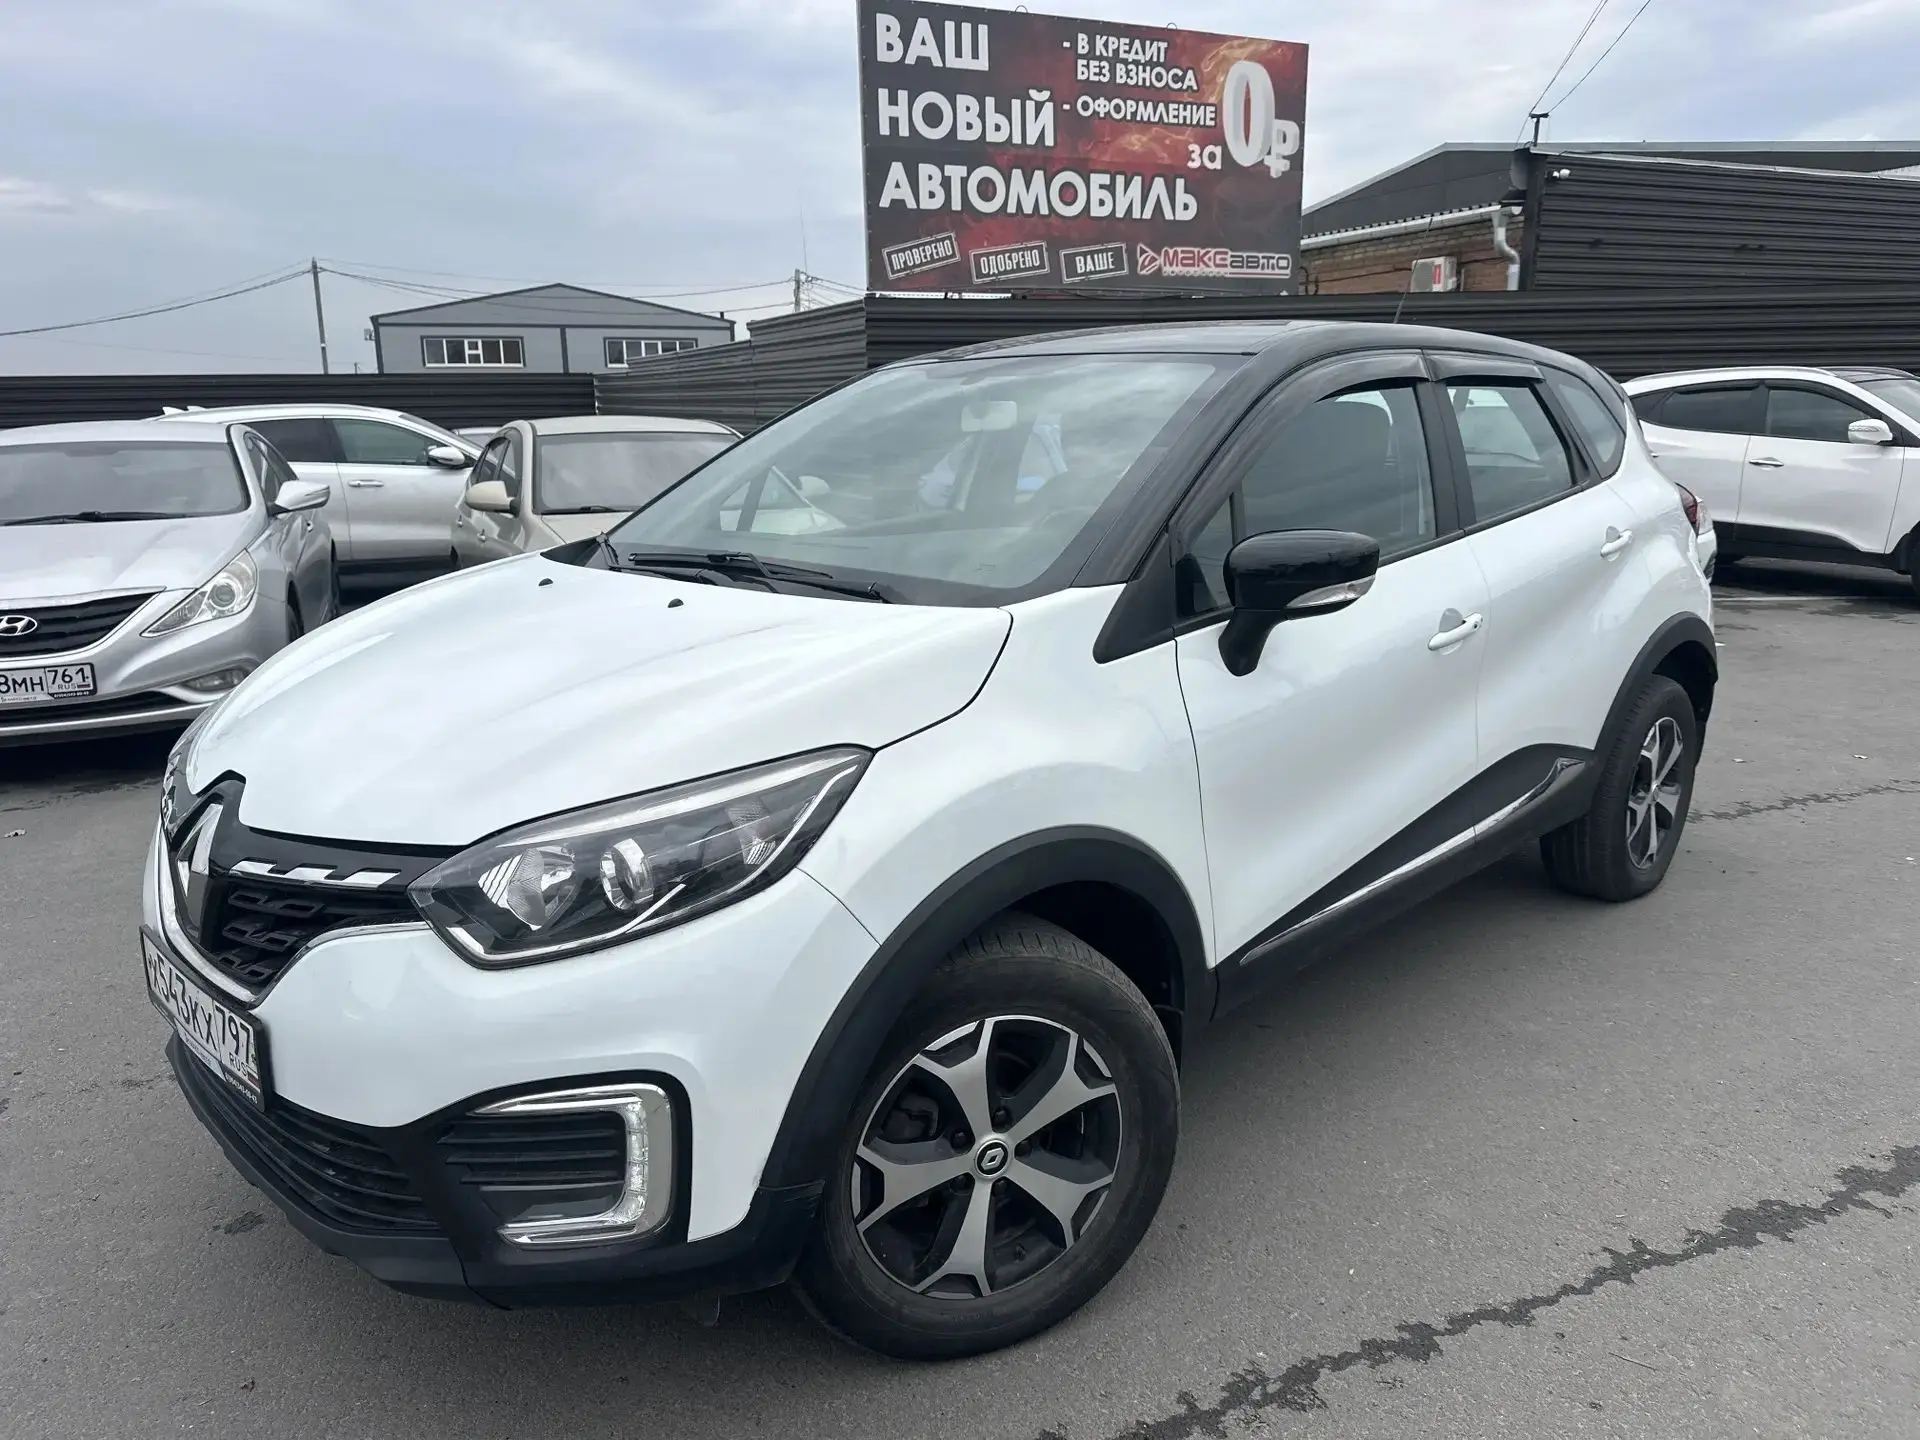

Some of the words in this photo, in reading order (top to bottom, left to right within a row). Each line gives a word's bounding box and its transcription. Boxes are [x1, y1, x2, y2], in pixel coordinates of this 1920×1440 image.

[876, 12, 989, 71] ВАШ
[1077, 33, 1090, 55] В
[1095, 34, 1168, 63] КРЕДИТ
[1076, 58, 1111, 83] БЕЗ
[1116, 62, 1199, 91] ВЗНОСА
[878, 87, 1055, 147] НОВЫЙ
[1076, 94, 1217, 127] ОФОРМЛЕНИЕ
[1187, 143, 1223, 171] за
[878, 161, 1198, 221] АВТОМОБИЛЬ
[890, 239, 954, 271] ПРОВЕРЕНО
[980, 249, 1041, 275] ОДОБРЕНО
[1074, 251, 1116, 274] ВАШЕ
[47, 667, 86, 686] 761
[57, 683, 77, 691] RUS
[215, 1004, 250, 1066] 797
[228, 1052, 248, 1077] RUS
